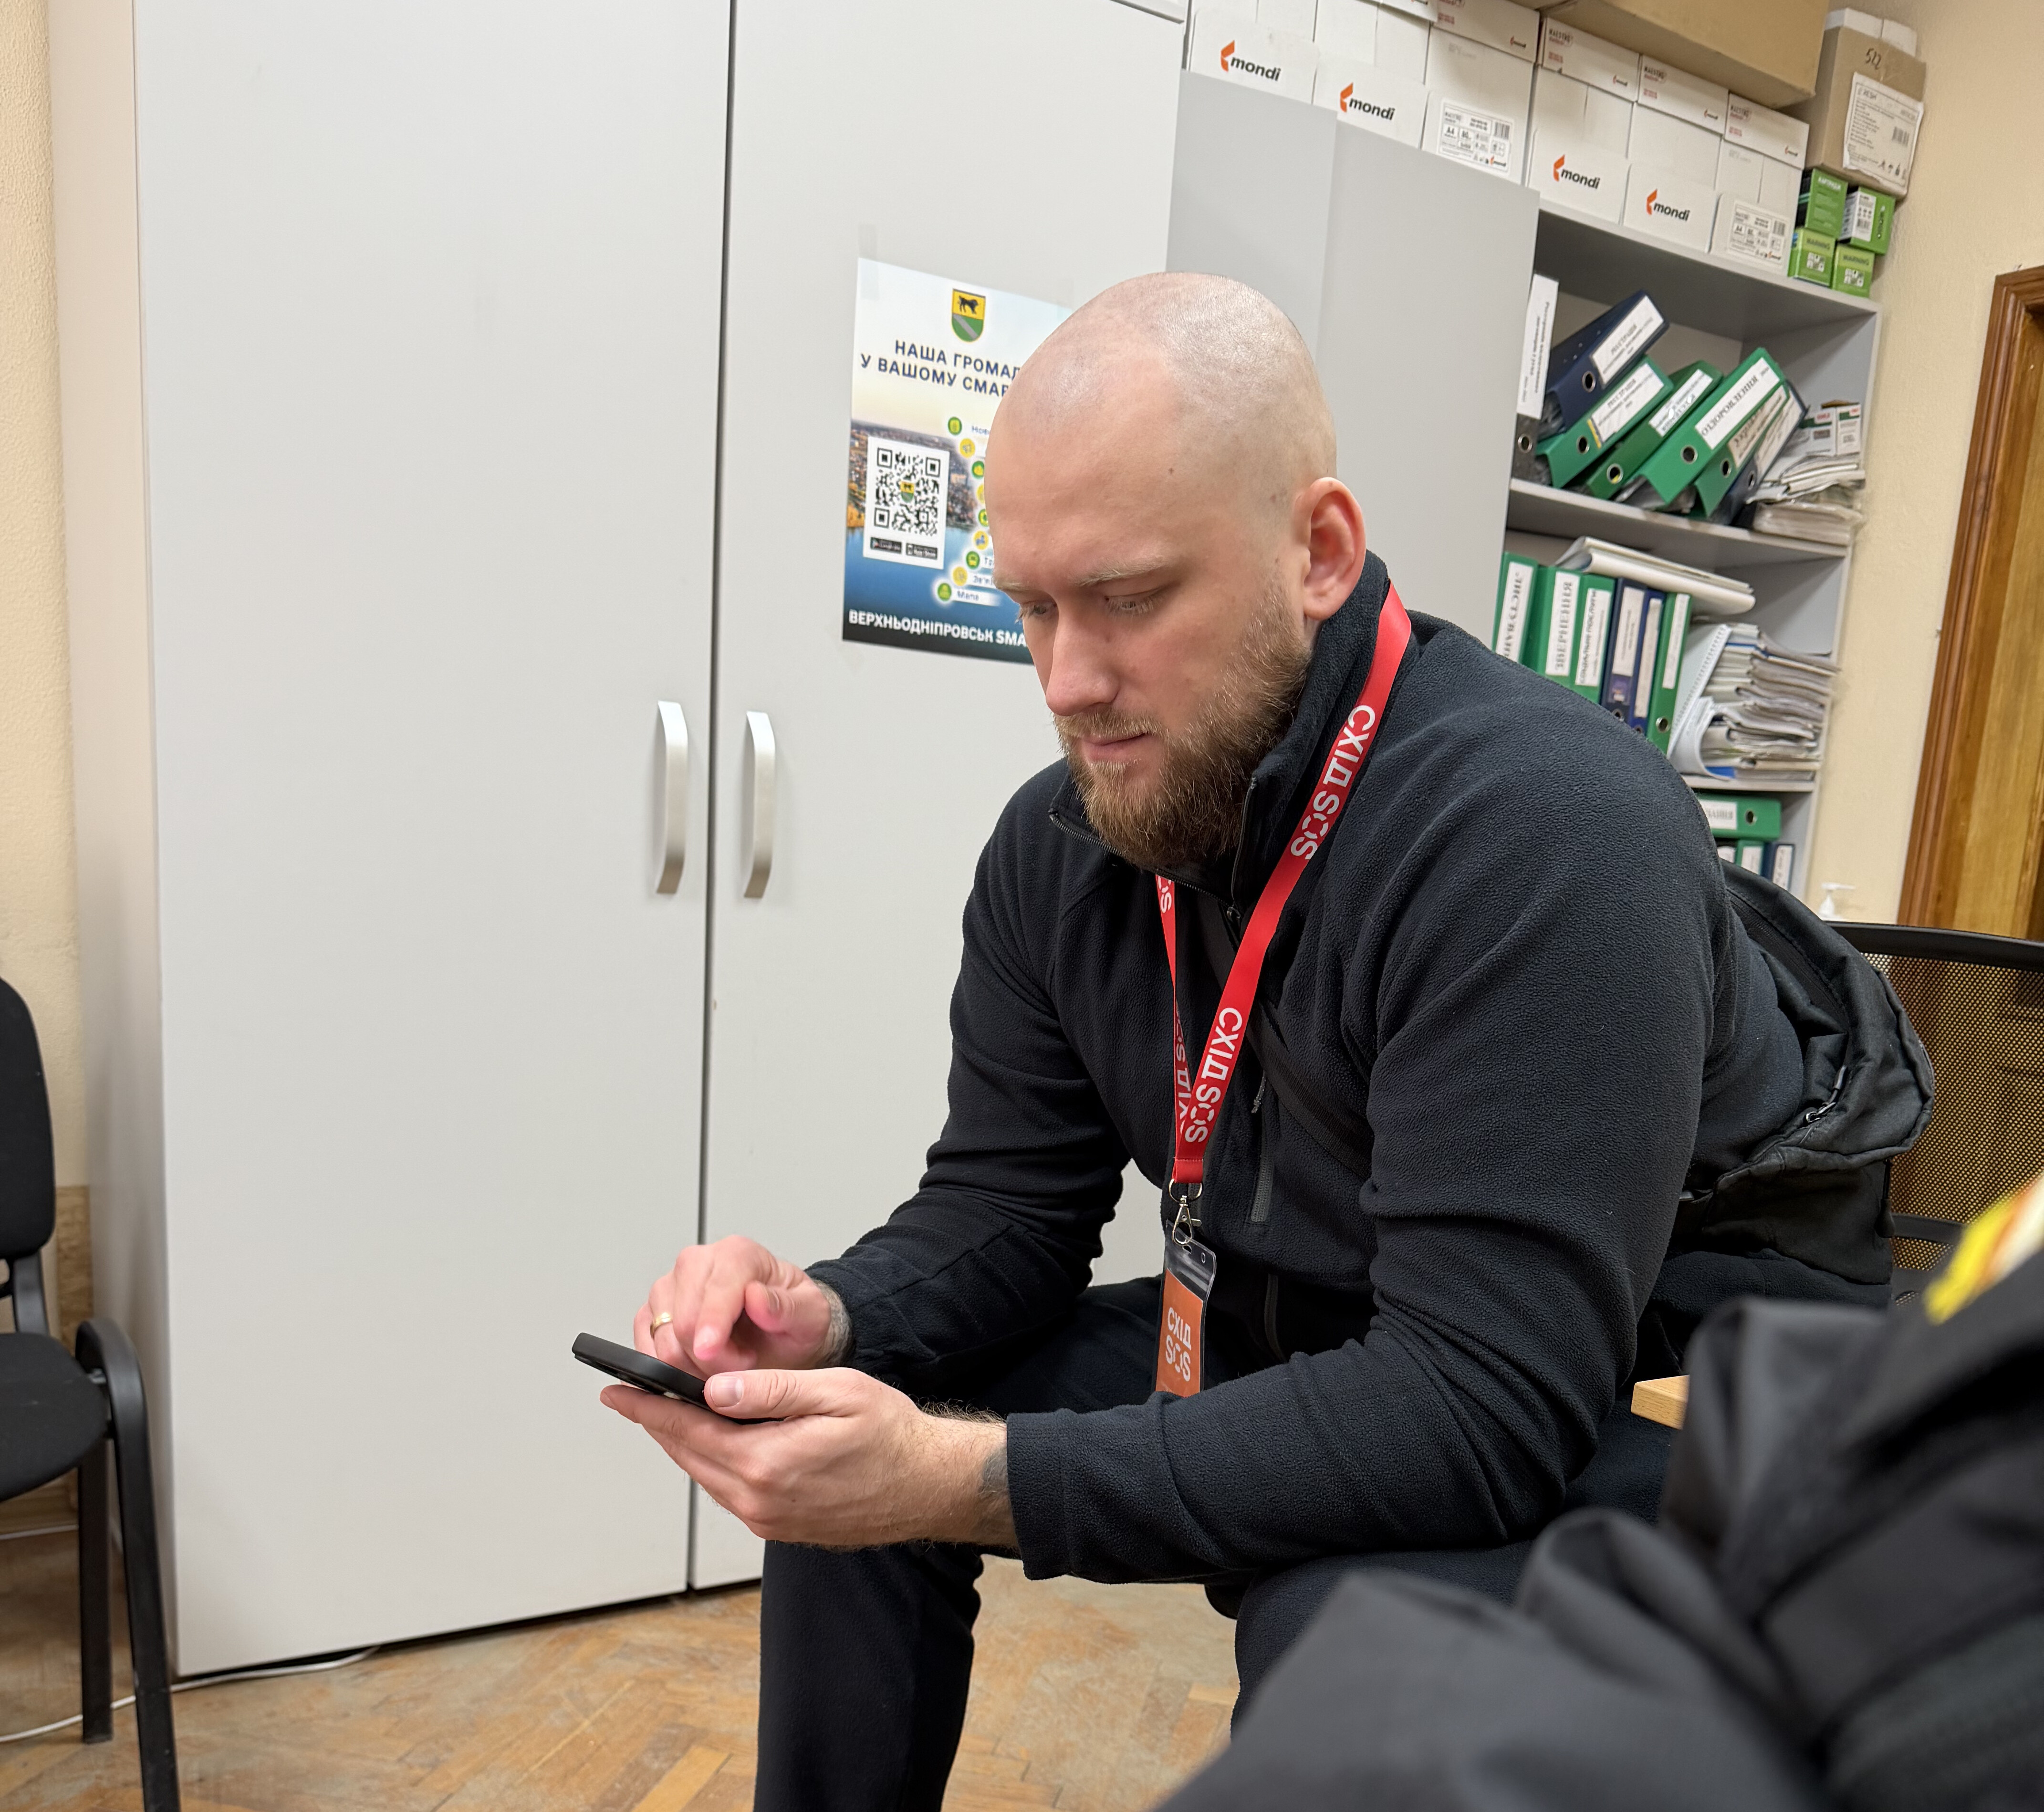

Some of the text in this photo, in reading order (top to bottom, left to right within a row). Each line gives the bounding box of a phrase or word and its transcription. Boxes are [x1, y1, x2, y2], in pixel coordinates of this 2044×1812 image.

[1230, 56, 1281, 82] mondi
[1348, 96, 1396, 121] mondi
[1561, 168, 1601, 189] mondi
[1653, 202, 1690, 221] mondi
[895, 340, 947, 364] НАША
[860, 353, 1009, 397] У ВАШОМУ СМАР
[848, 608, 1027, 647] ВЕРХНЬОДНІПРОВСЬК SMA
[1290, 705, 1376, 860] СХІД SOS
[1185, 1007, 1243, 1143] СХІД SOS
[1167, 1307, 1192, 1351] СХІД
[1165, 1334, 1191, 1382] SOS
